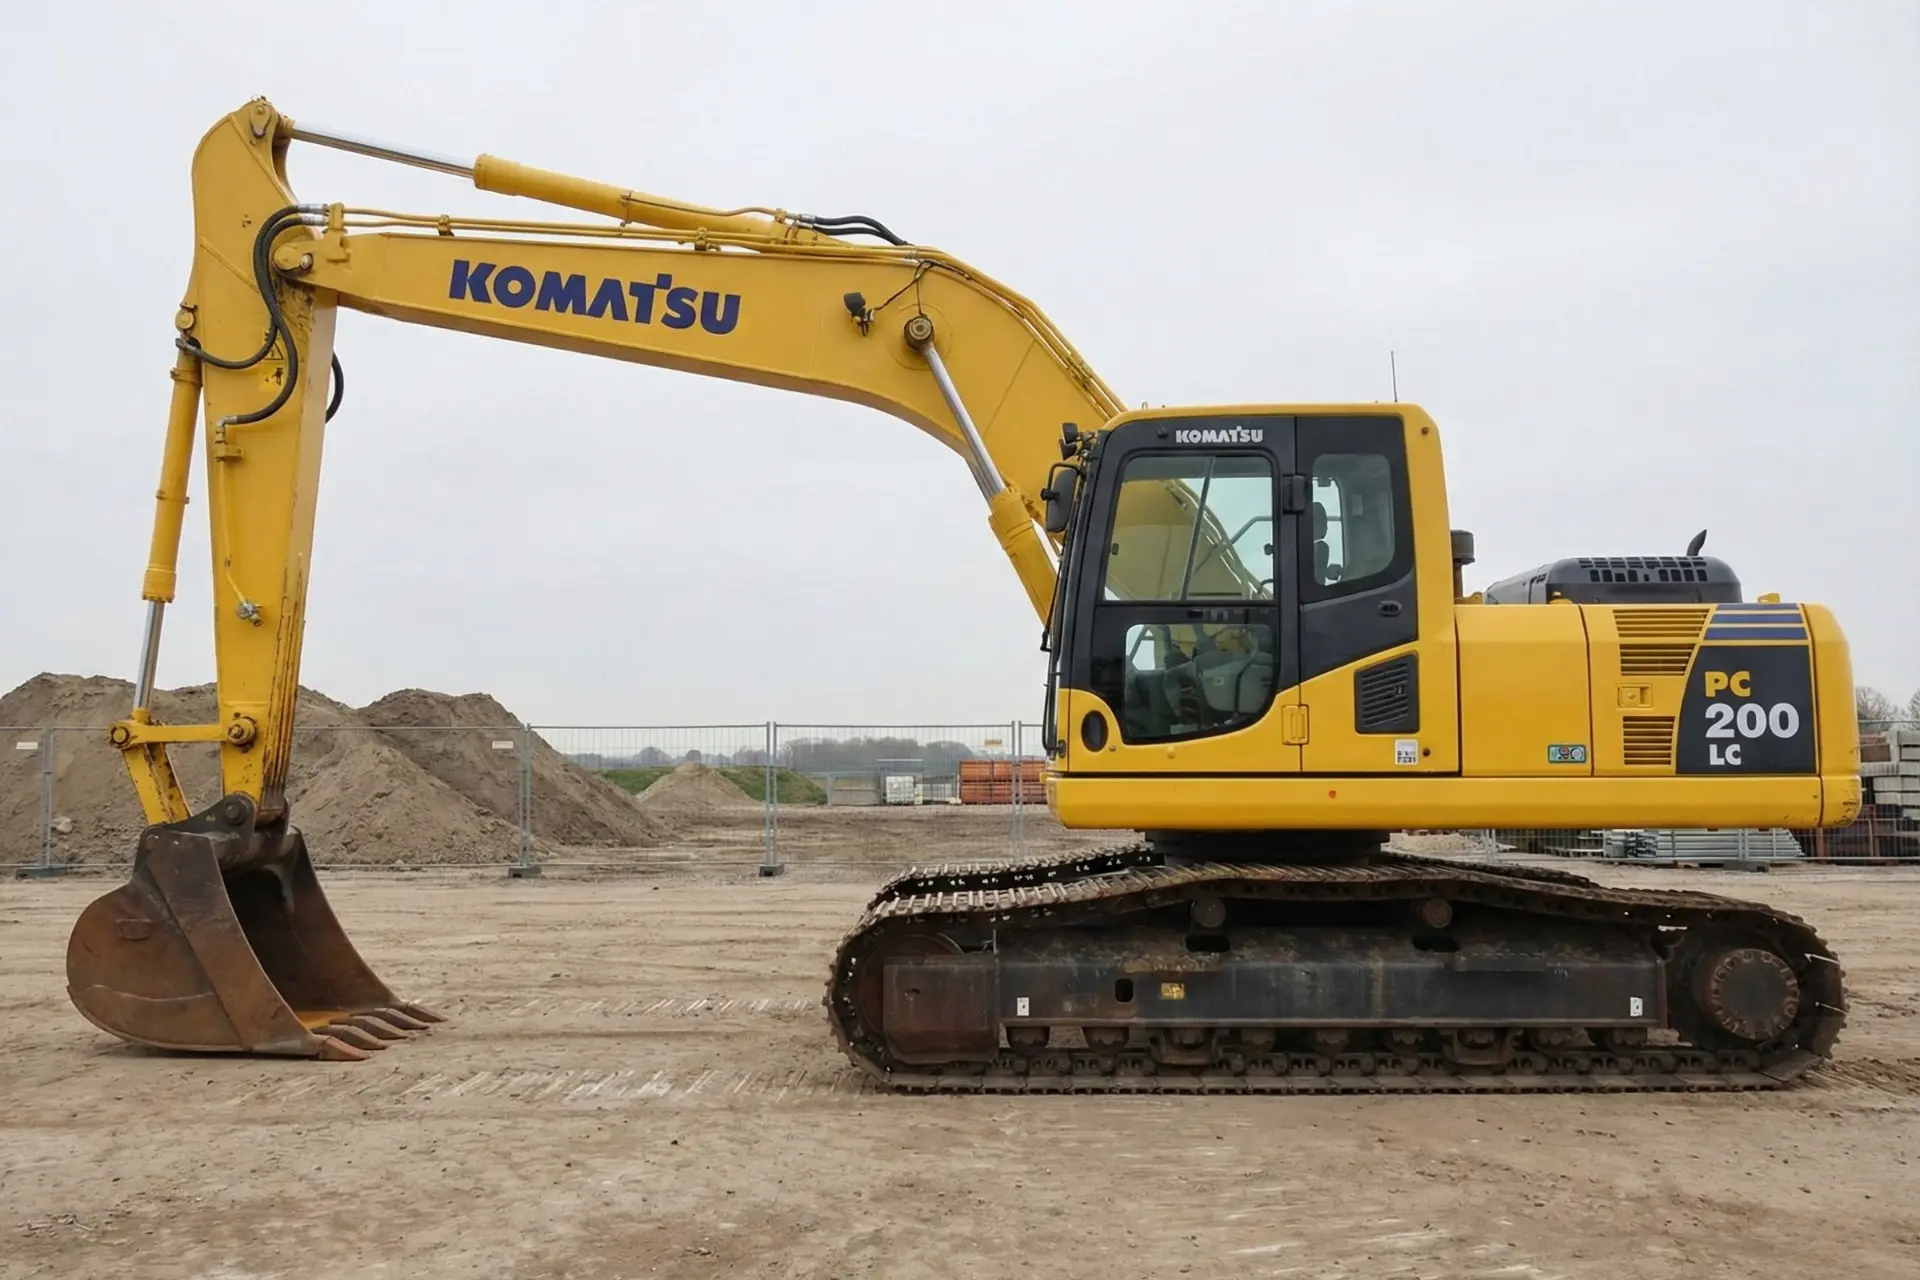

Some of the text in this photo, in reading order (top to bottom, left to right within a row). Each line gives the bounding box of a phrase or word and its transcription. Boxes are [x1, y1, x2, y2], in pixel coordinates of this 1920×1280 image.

[449, 260, 740, 334] KOMATSU
[1175, 425, 1264, 444] KOMATSU
[1704, 671, 1751, 697] PC
[1705, 702, 1800, 739] 200
[1709, 743, 1742, 766] LC
